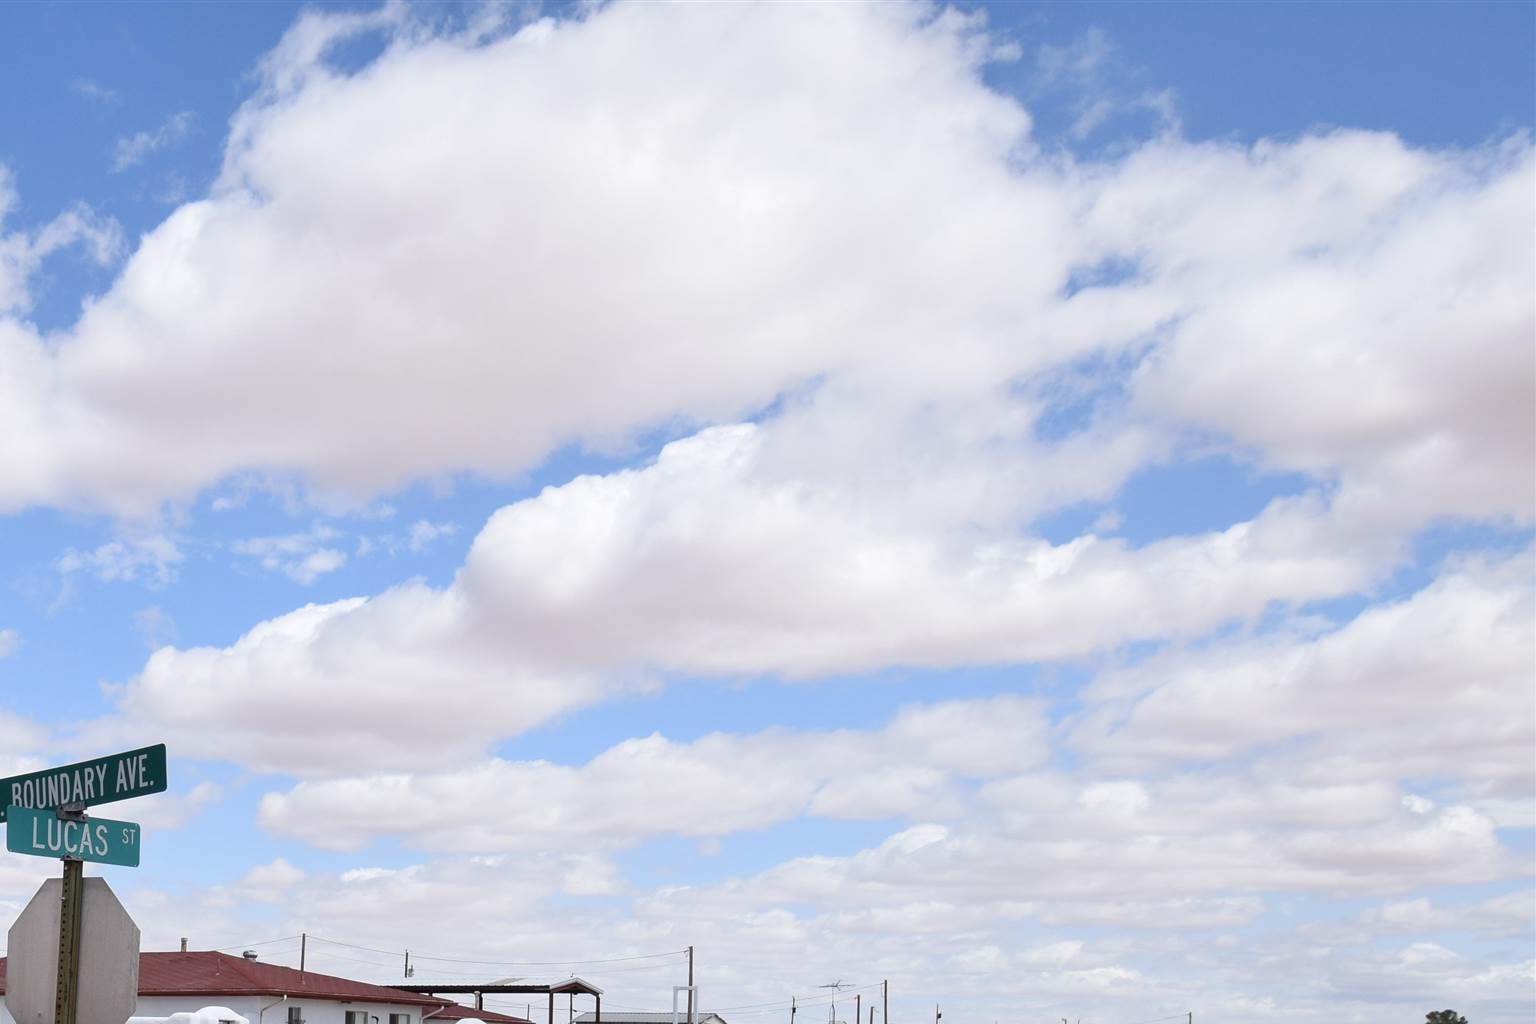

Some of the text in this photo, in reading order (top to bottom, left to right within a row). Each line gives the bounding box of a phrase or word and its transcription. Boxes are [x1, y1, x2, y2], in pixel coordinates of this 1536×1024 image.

[12, 763, 108, 809] BOUNDARY
[116, 754, 154, 793] AVE.
[32, 817, 136, 856] LUCAS ST
